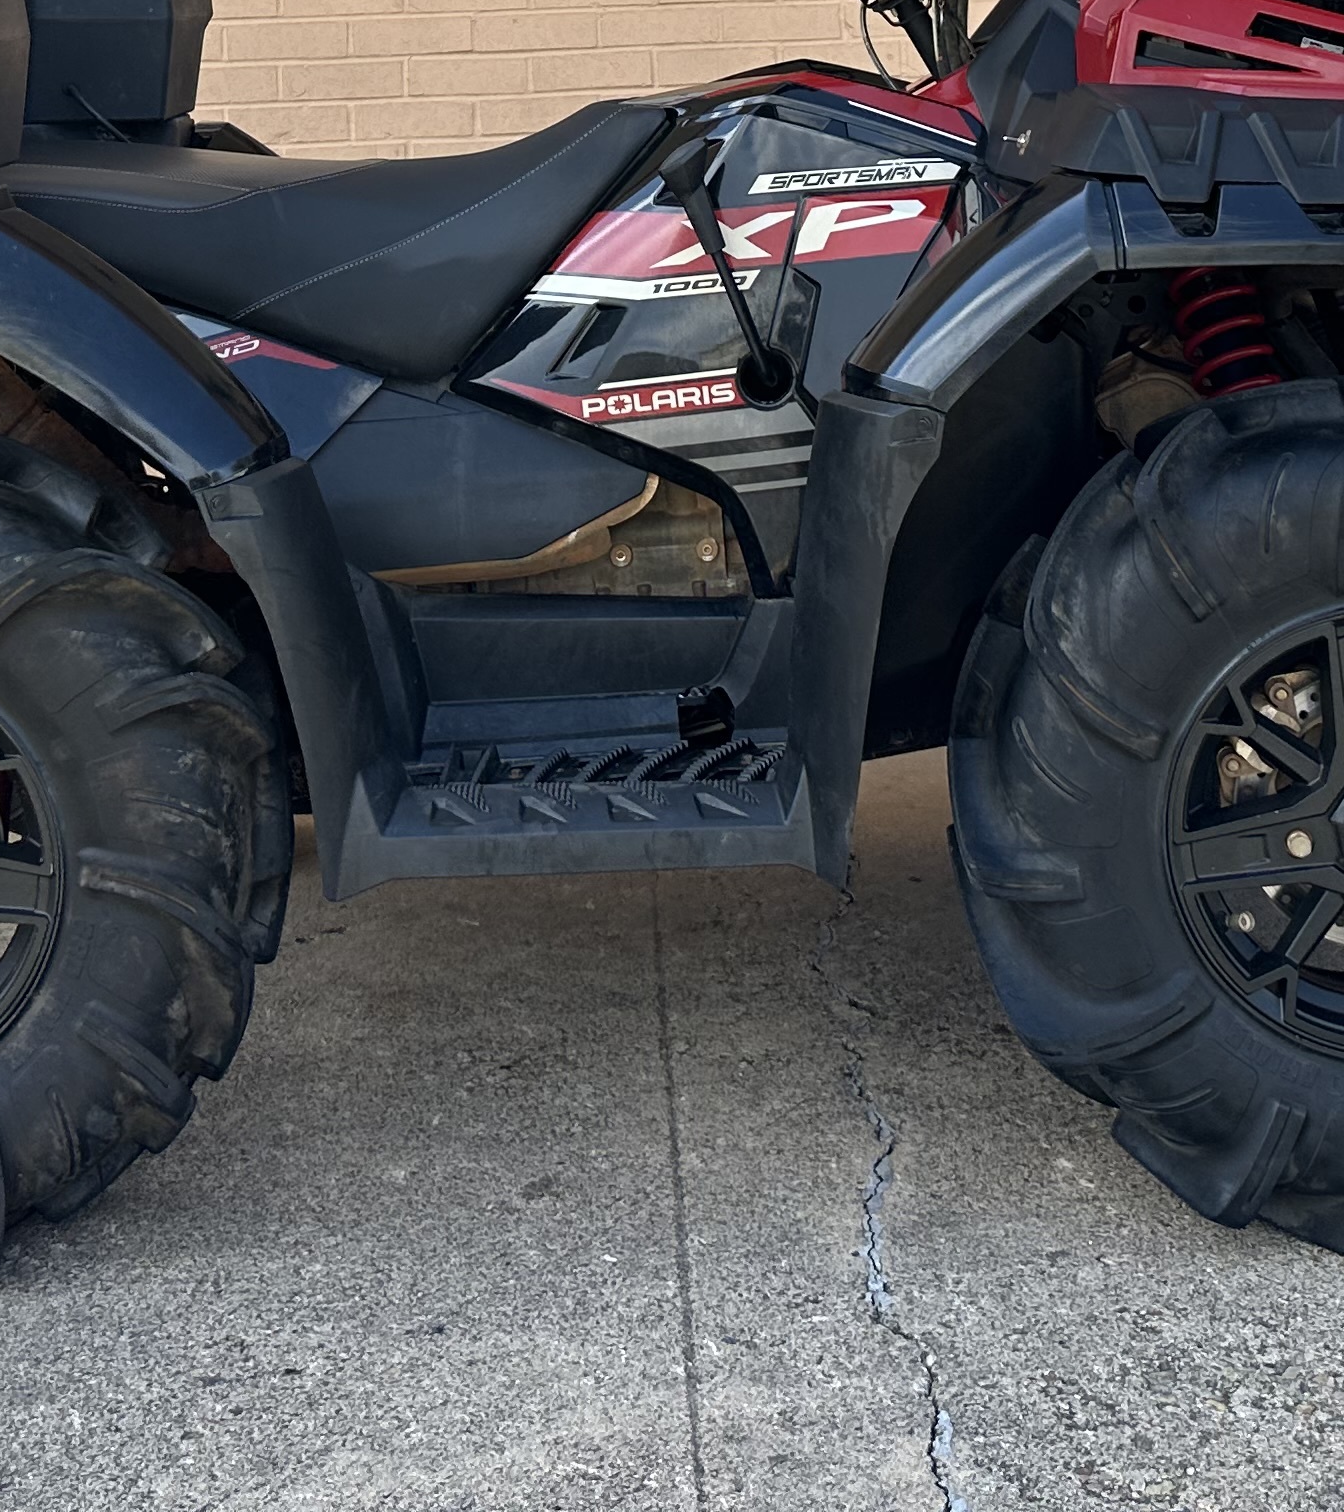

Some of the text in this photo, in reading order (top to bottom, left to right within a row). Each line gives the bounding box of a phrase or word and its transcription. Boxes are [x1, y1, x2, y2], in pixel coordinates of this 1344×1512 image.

[767, 164, 928, 190] SPORTSMAN
[648, 199, 927, 269] XP
[582, 382, 737, 420] POLARIS
